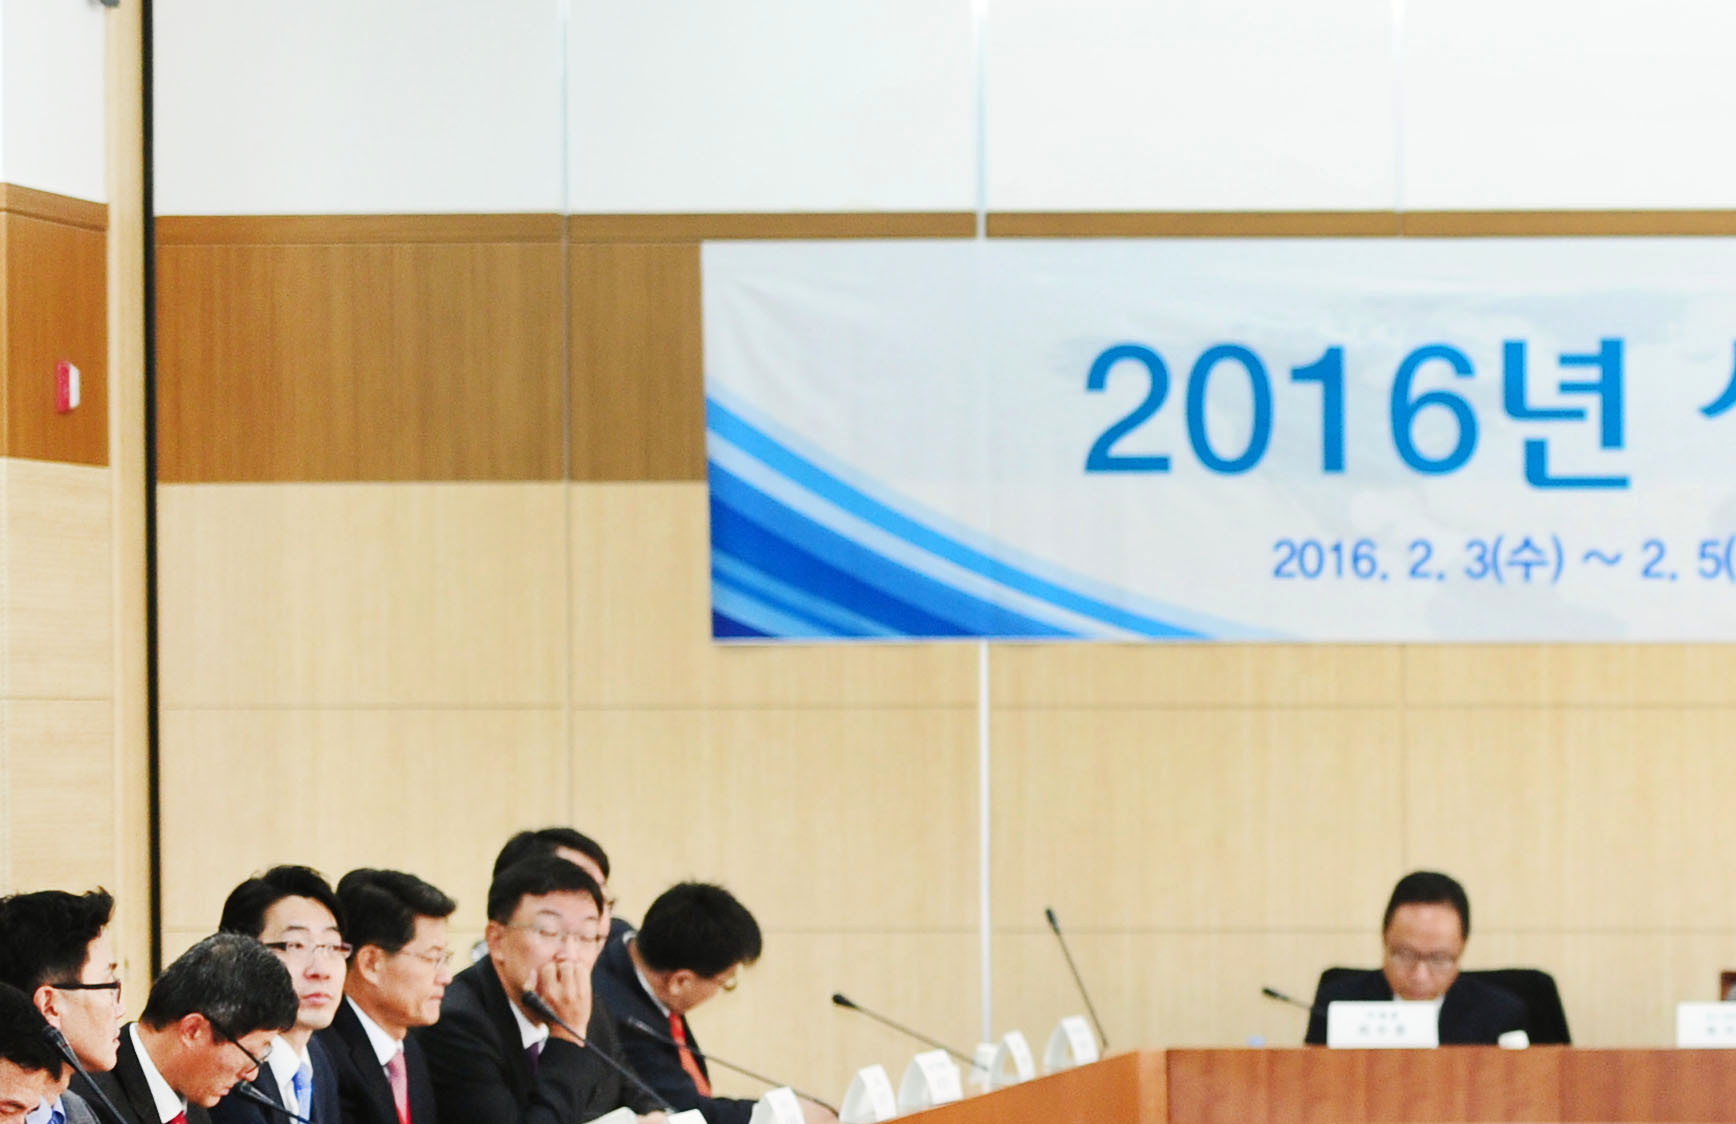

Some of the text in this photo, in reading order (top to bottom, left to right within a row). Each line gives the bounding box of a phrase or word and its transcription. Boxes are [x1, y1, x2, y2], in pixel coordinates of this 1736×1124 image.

[1085, 337, 1634, 491] 2016년
[1272, 538, 1390, 583] 2016.
[1408, 539, 1447, 583] 2.
[1464, 535, 1566, 585] 3(수)
[1641, 539, 1680, 583] 2.
